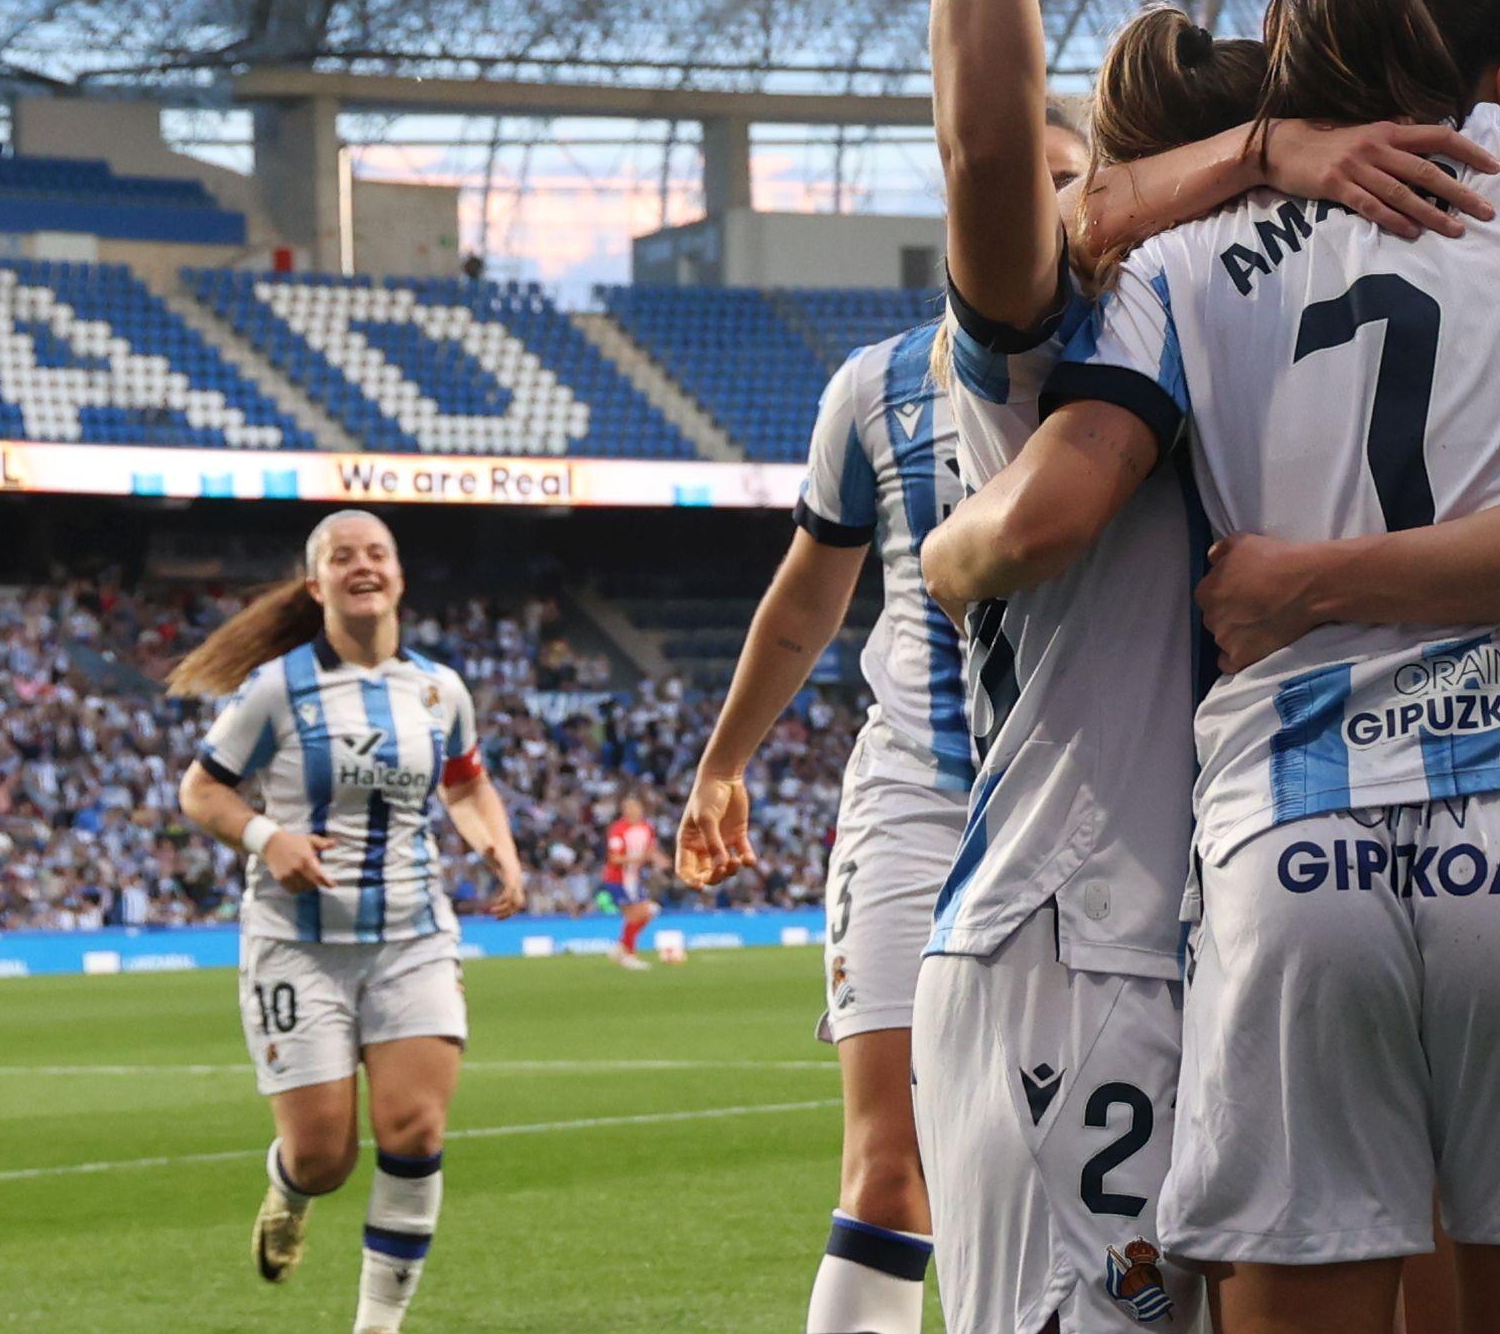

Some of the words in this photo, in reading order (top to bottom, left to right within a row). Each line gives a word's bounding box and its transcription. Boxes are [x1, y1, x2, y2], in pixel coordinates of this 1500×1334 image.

[1294, 273, 1440, 531] 7
[338, 461, 399, 493] We
[413, 468, 476, 495] are
[490, 463, 573, 498] Real
[831, 859, 857, 945] 3
[254, 981, 296, 1036] 10
